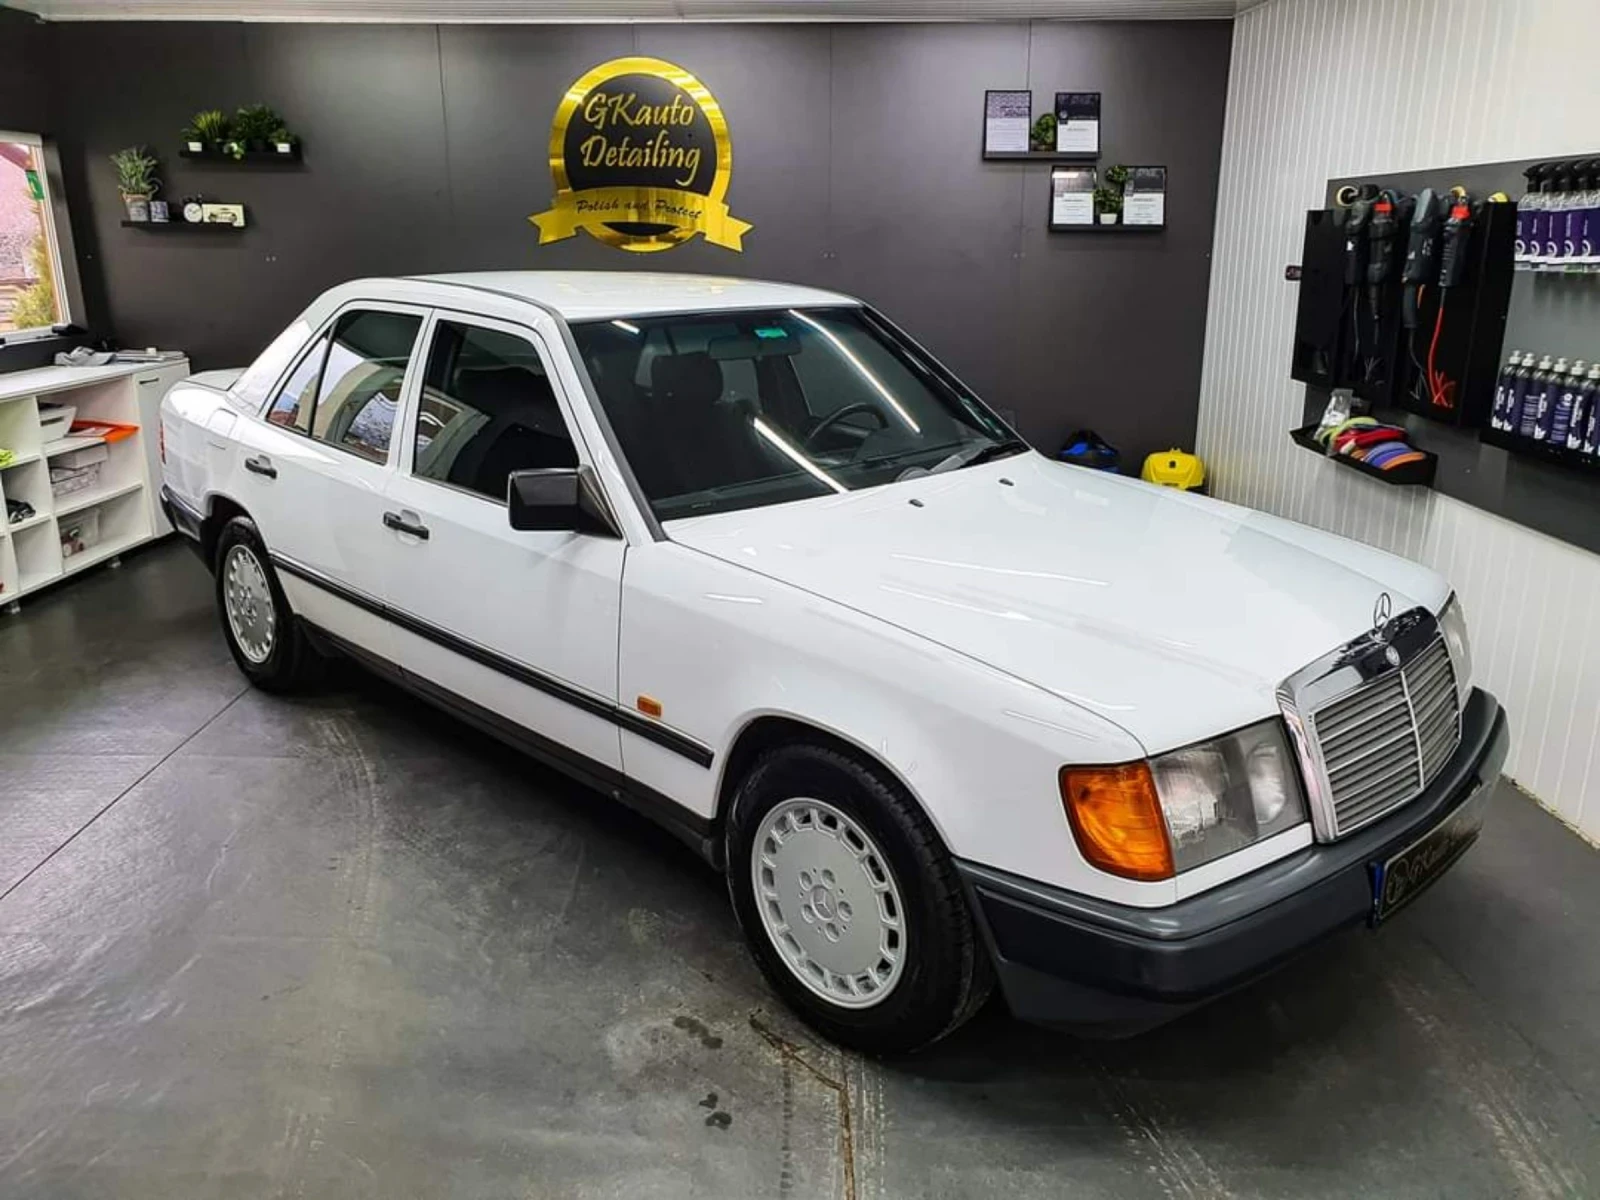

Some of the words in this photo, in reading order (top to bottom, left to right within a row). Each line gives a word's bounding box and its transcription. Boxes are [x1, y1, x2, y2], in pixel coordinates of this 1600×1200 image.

[584, 93, 694, 130] GKauto
[580, 129, 701, 187] Detailing
[575, 198, 620, 214] Polish
[623, 199, 650, 211] and
[654, 199, 702, 219] Protect
